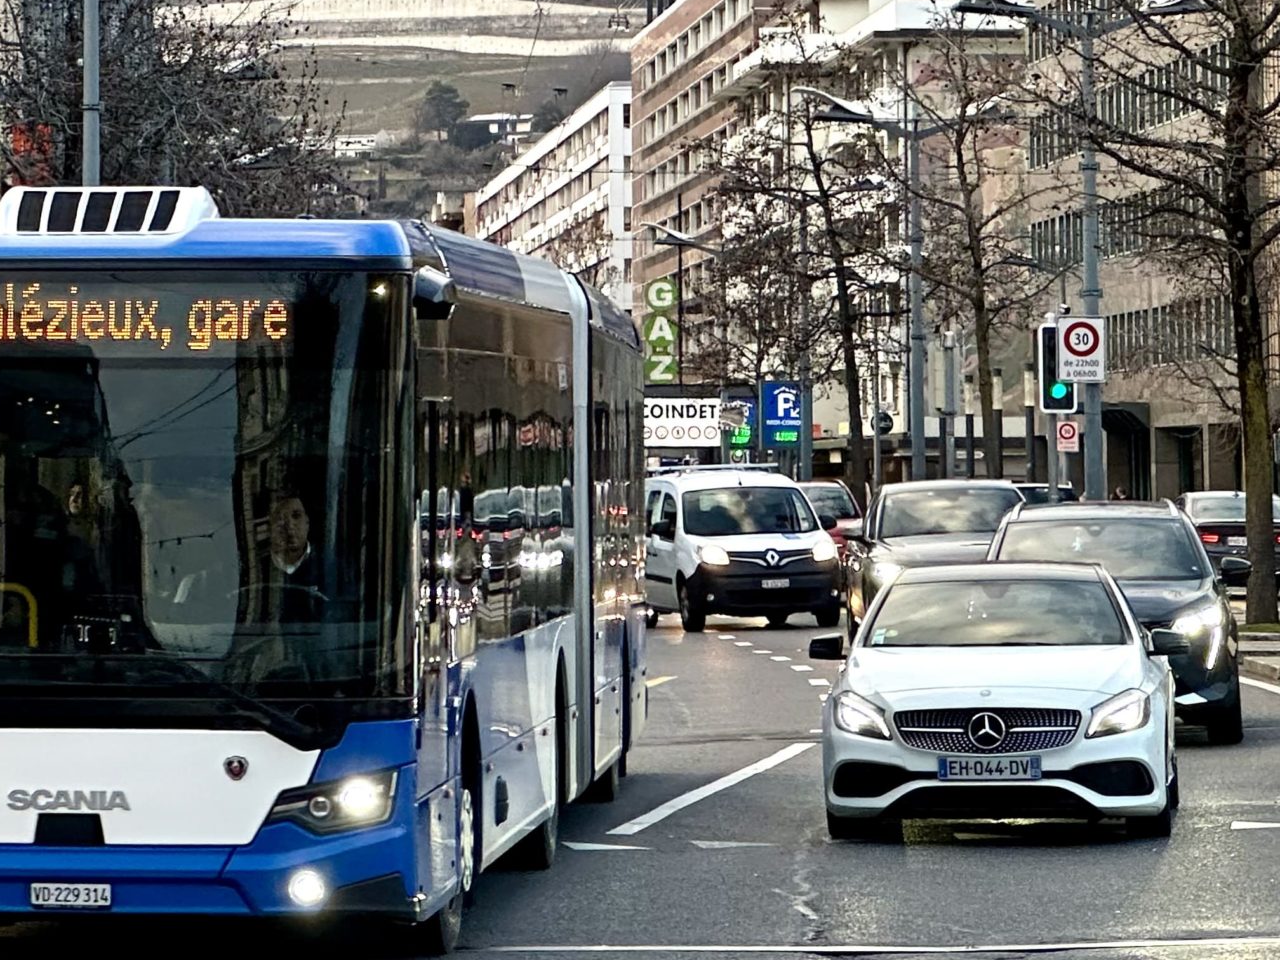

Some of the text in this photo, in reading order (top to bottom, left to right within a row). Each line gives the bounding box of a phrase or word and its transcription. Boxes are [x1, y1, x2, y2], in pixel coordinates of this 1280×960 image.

[188, 300, 287, 350] gare
[648, 282, 674, 380] GAZ
[1073, 333, 1089, 346] 30
[949, 760, 1029, 776] EH-044-DV
[7, 789, 131, 811] SCANIA
[83, 888, 109, 903] 314
